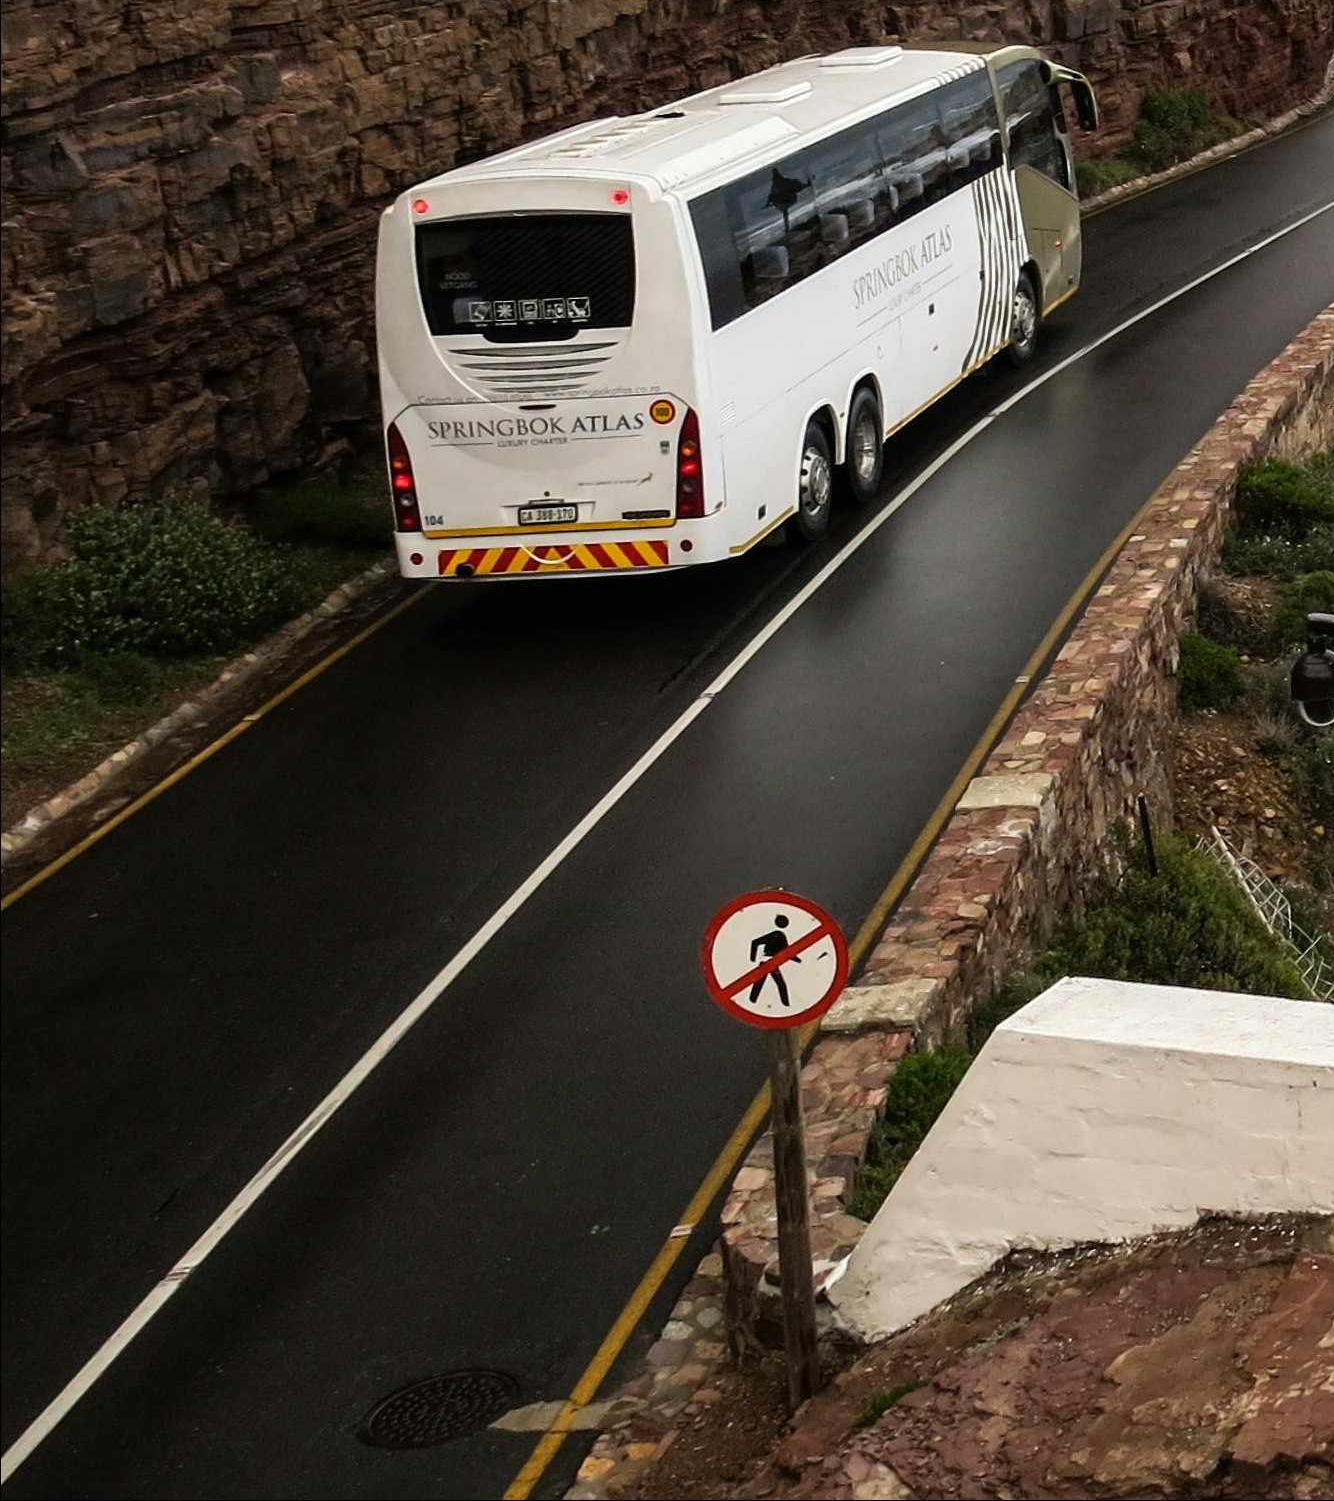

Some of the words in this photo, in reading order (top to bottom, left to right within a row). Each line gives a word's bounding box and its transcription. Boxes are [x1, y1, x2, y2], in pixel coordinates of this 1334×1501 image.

[852, 244, 920, 310] SPRINGBOK
[920, 224, 954, 269] ATLAS
[427, 417, 565, 440] SPRINGBOK
[570, 413, 645, 434] ATLAS
[496, 439, 528, 448] LUXURY
[530, 437, 568, 446] CHARTER
[424, 515, 445, 526] 104
